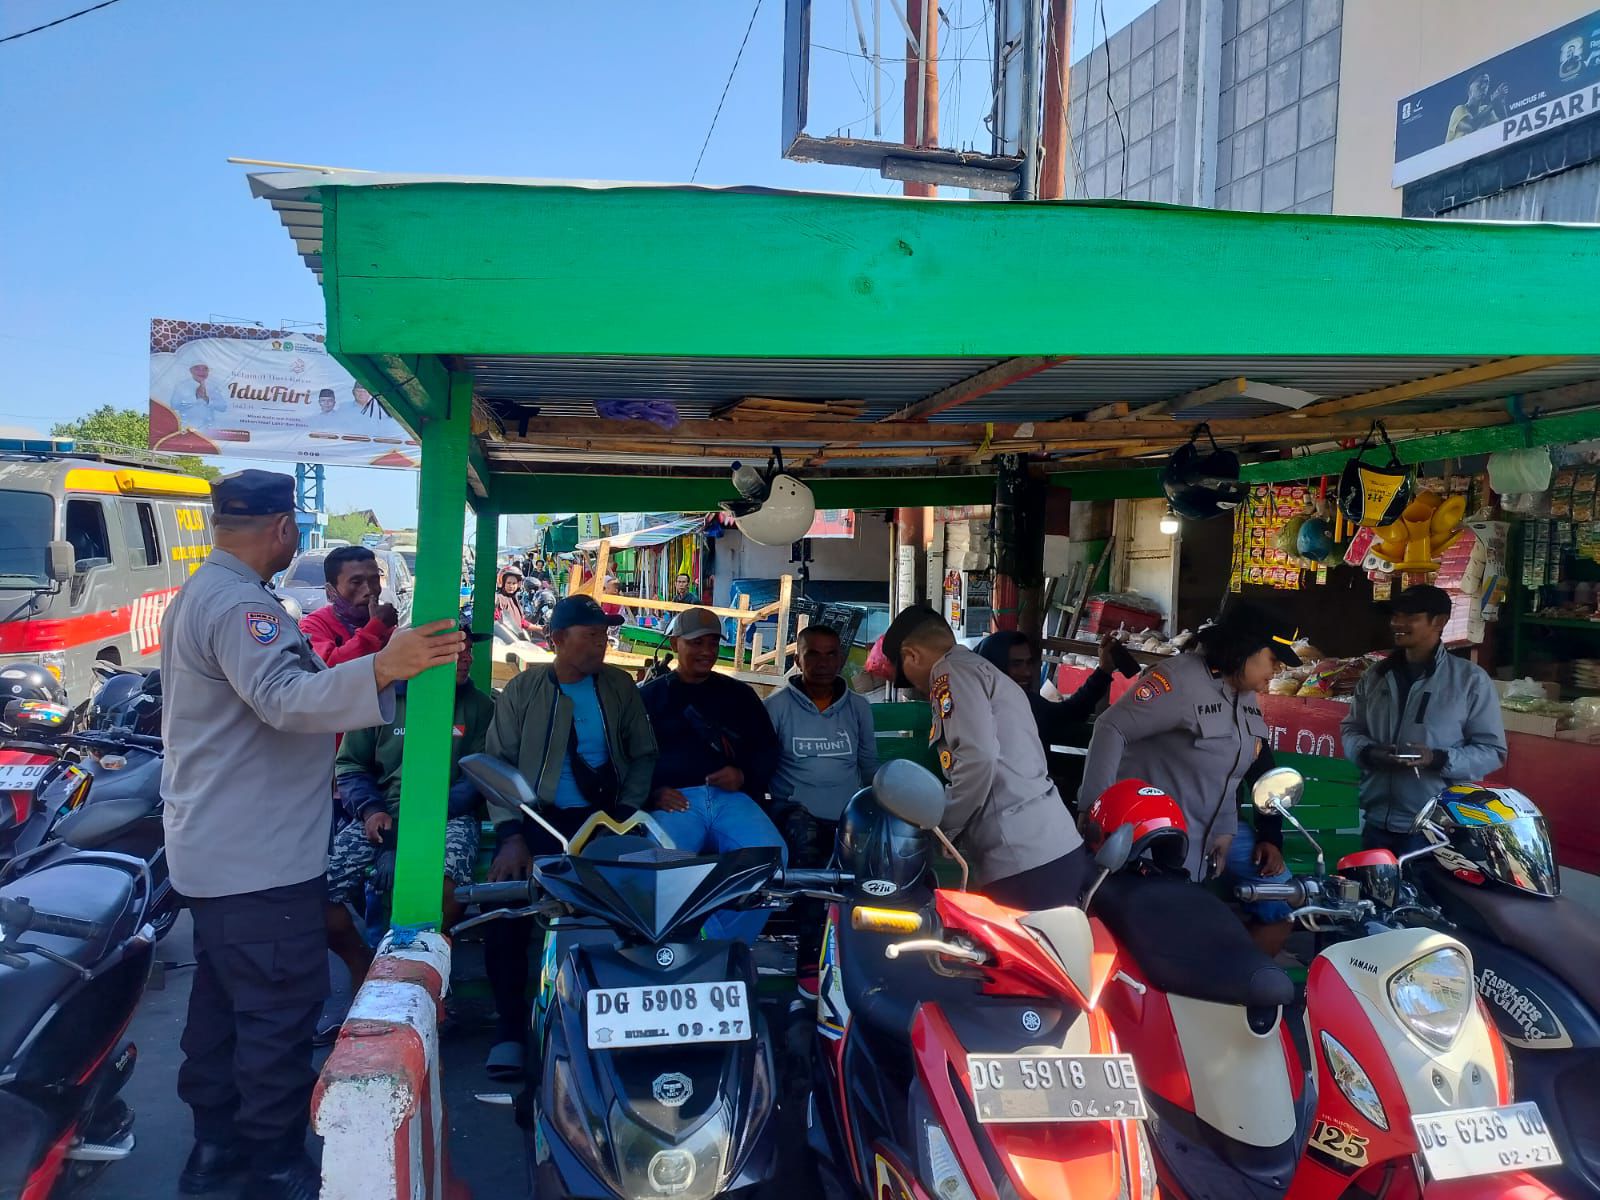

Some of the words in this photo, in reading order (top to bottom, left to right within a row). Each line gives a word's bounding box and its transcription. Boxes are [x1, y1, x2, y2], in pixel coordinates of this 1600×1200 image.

[1509, 93, 1537, 111] VINICIUS
[1502, 93, 1585, 142] PASAR
[1197, 702, 1222, 715] FANY
[815, 740, 845, 751] HUNT
[1349, 957, 1379, 975] YAMAHA
[595, 991, 630, 1016] DG
[642, 987, 698, 1012] 5908
[710, 985, 741, 1012] QG
[970, 1060, 1004, 1091] DG
[1019, 1059, 1086, 1089] 5918
[1311, 1120, 1368, 1159] 125
[1416, 1121, 1447, 1149] DG
